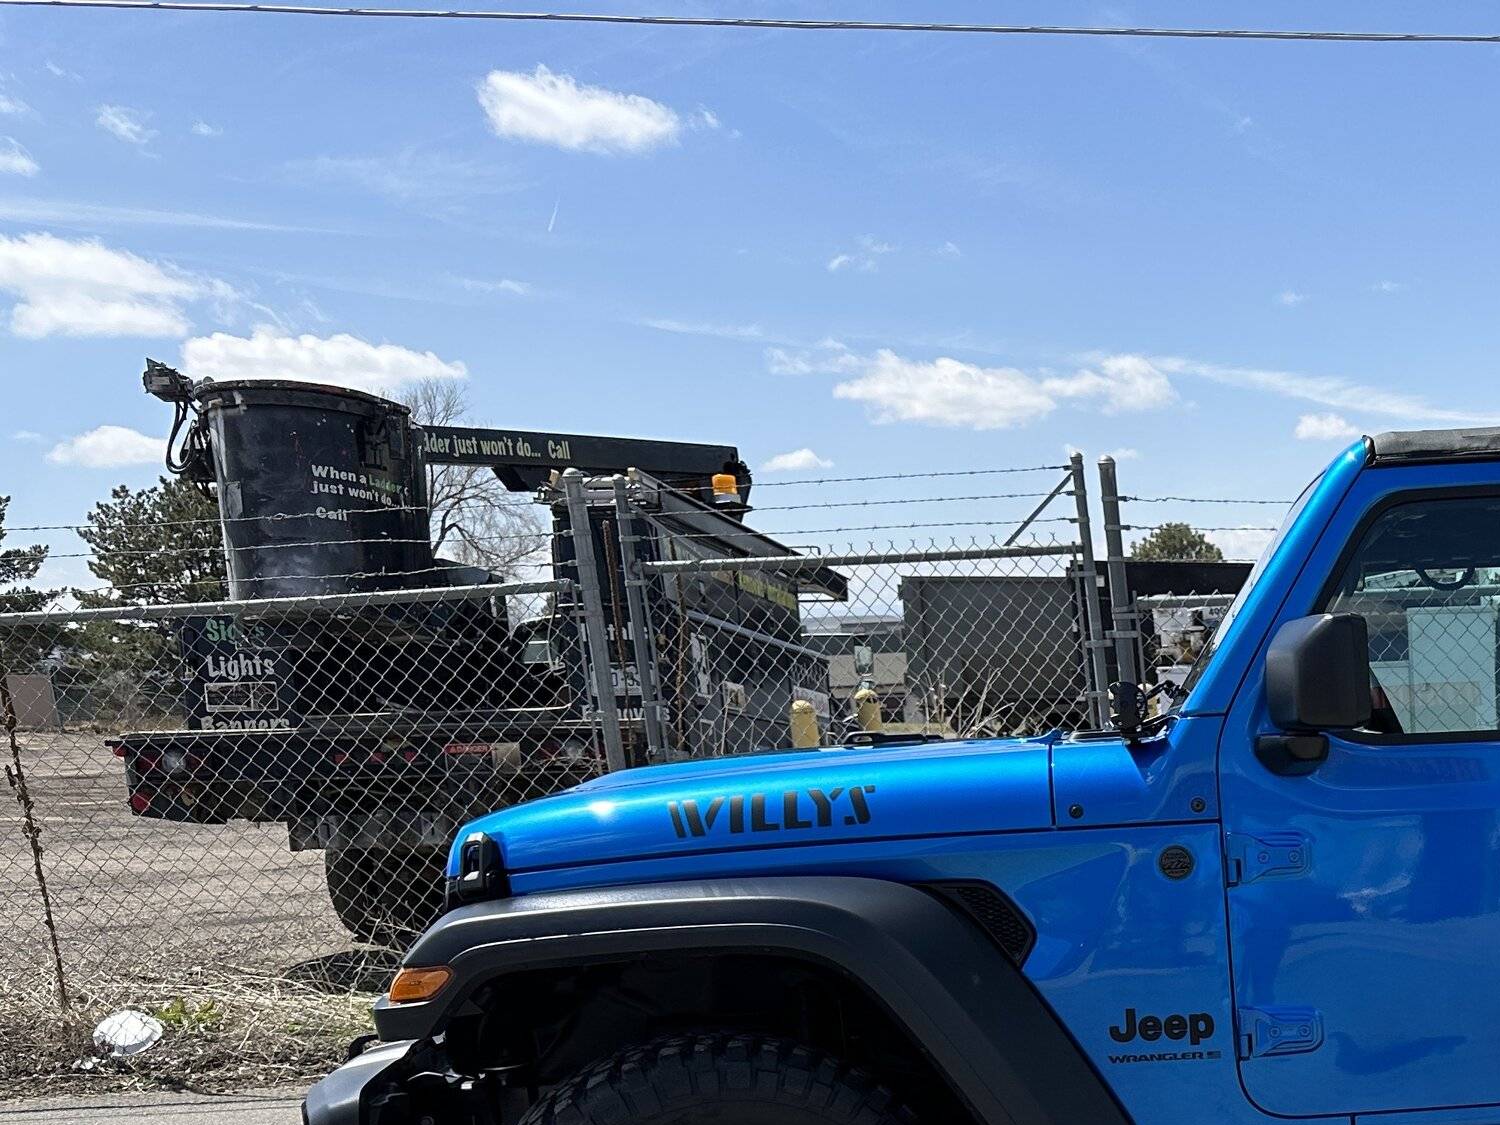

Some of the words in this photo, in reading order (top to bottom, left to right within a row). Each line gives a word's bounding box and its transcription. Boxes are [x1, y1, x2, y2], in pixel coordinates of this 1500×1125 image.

[423, 432, 449, 453] dder
[453, 435, 478, 457] just
[480, 437, 513, 456] won't
[517, 438, 541, 457] do...
[548, 440, 570, 460] Call
[310, 481, 344, 495] just
[348, 487, 379, 502] won't
[312, 464, 357, 482] When
[360, 475, 367, 484] a
[368, 474, 402, 494] Ladder
[316, 506, 348, 521] Call
[206, 653, 274, 681] Lights
[667, 785, 876, 839] WILLYS
[1109, 1008, 1214, 1045] Jeep
[1108, 1051, 1204, 1064] WRANGLER
